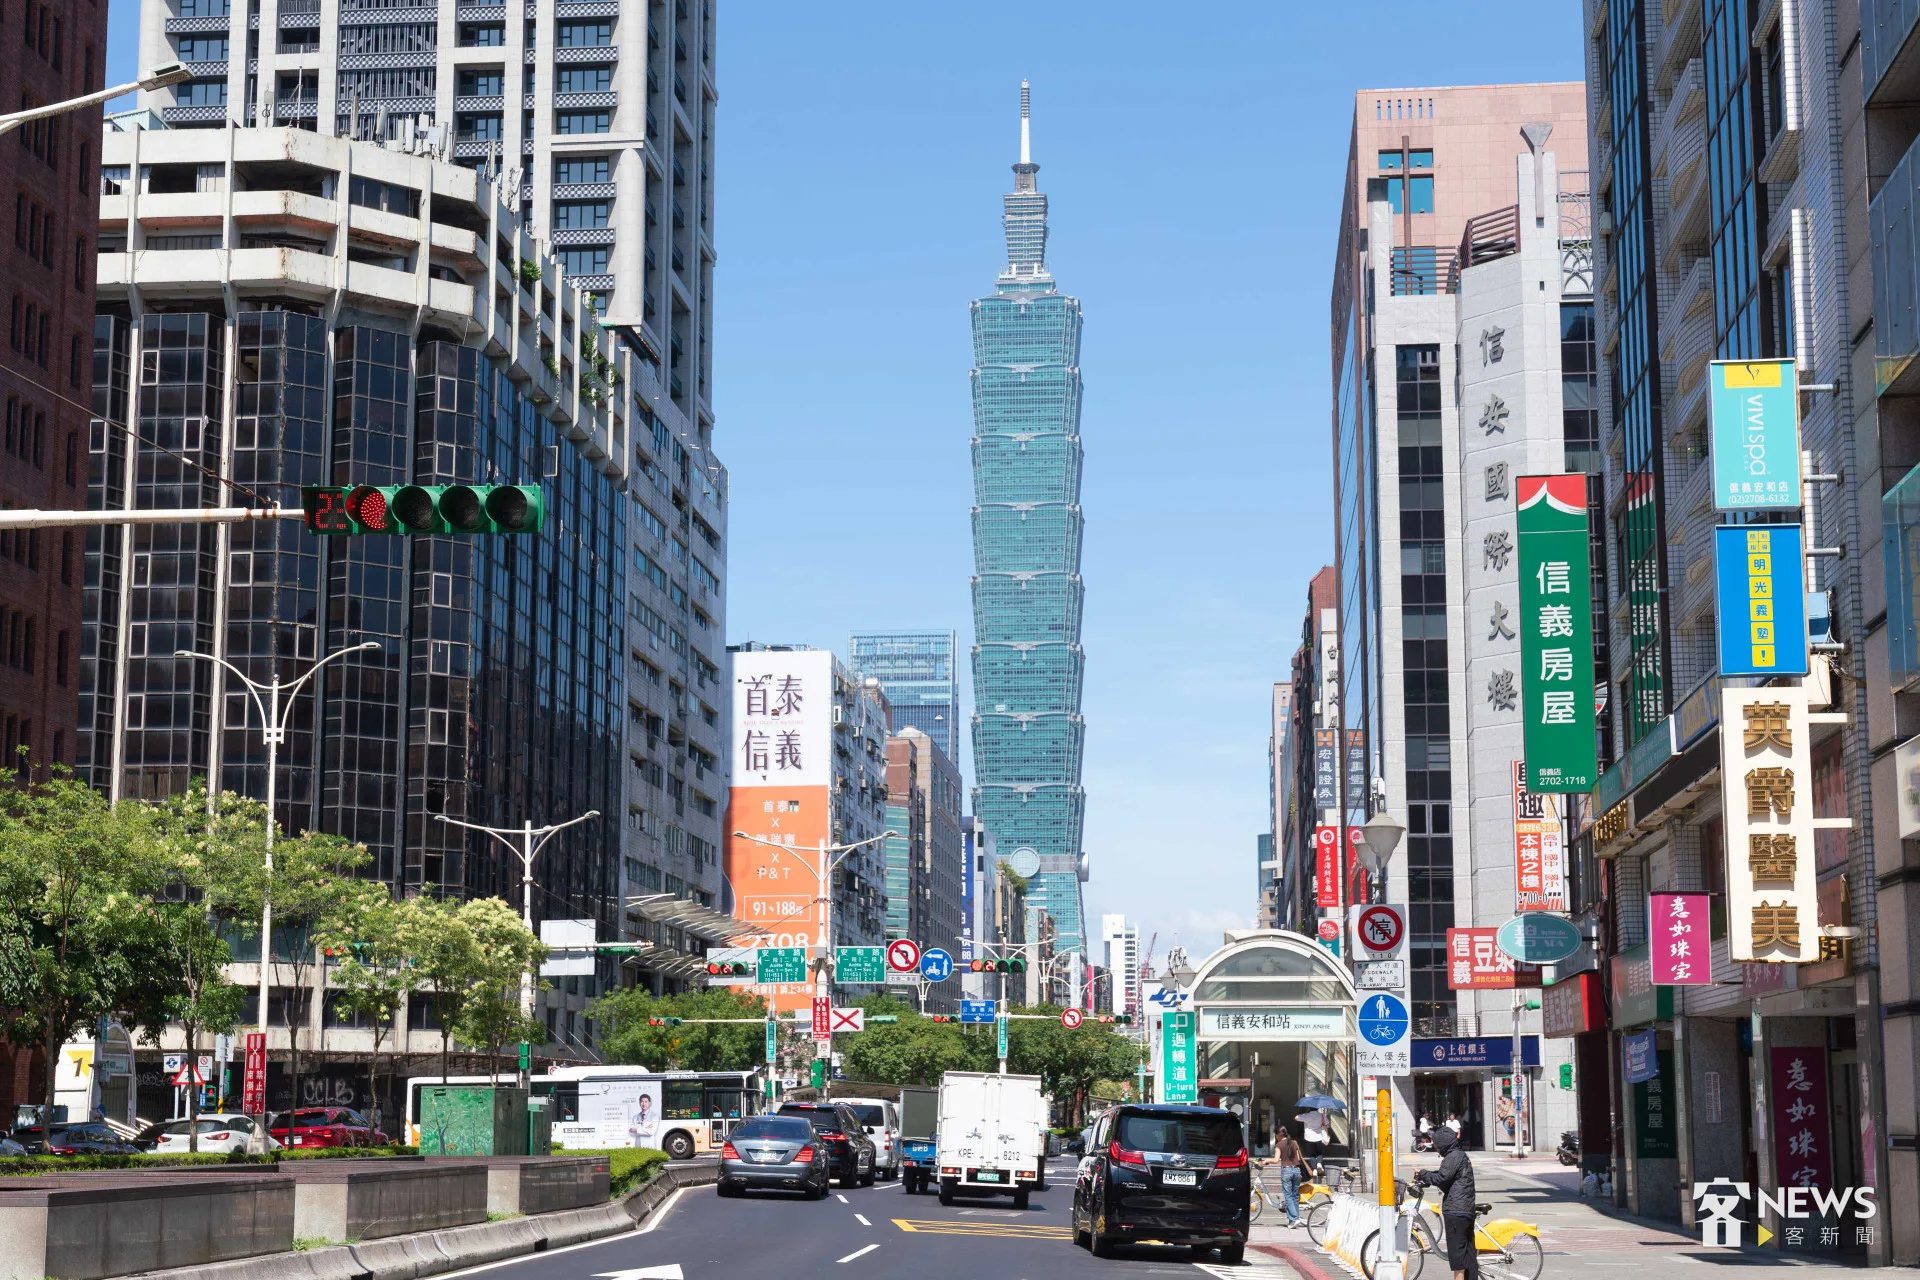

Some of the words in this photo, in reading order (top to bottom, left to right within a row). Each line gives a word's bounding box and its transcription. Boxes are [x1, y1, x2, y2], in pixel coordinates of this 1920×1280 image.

[1729, 480, 1788, 493] 信義安和店
[1728, 493, 1790, 505] (02)2708-6132
[1479, 324, 1518, 713] 信安國際大樓
[1536, 560, 1576, 725] 信義房屋
[744, 674, 803, 715] 首泰
[741, 729, 802, 771] 信義
[1539, 768, 1561, 776] 信義店
[1539, 776, 1586, 786] 2702-1718
[1519, 834, 1540, 888] 本棟2樓
[1369, 918, 1391, 941] 停
[761, 948, 801, 957] 安和路
[840, 948, 880, 957] 安和路
[1452, 933, 1471, 984] 信義
[1216, 1014, 1290, 1030] 信義安和站
[1171, 1032, 1188, 1081] 迴轉道
[1359, 1051, 1408, 1062] 行人優先
[73, 1057, 83, 1078] 1
[1166, 1083, 1194, 1091] U-turn
[1166, 1092, 1187, 1100] Lane
[1003, 1150, 1021, 1161] 8212
